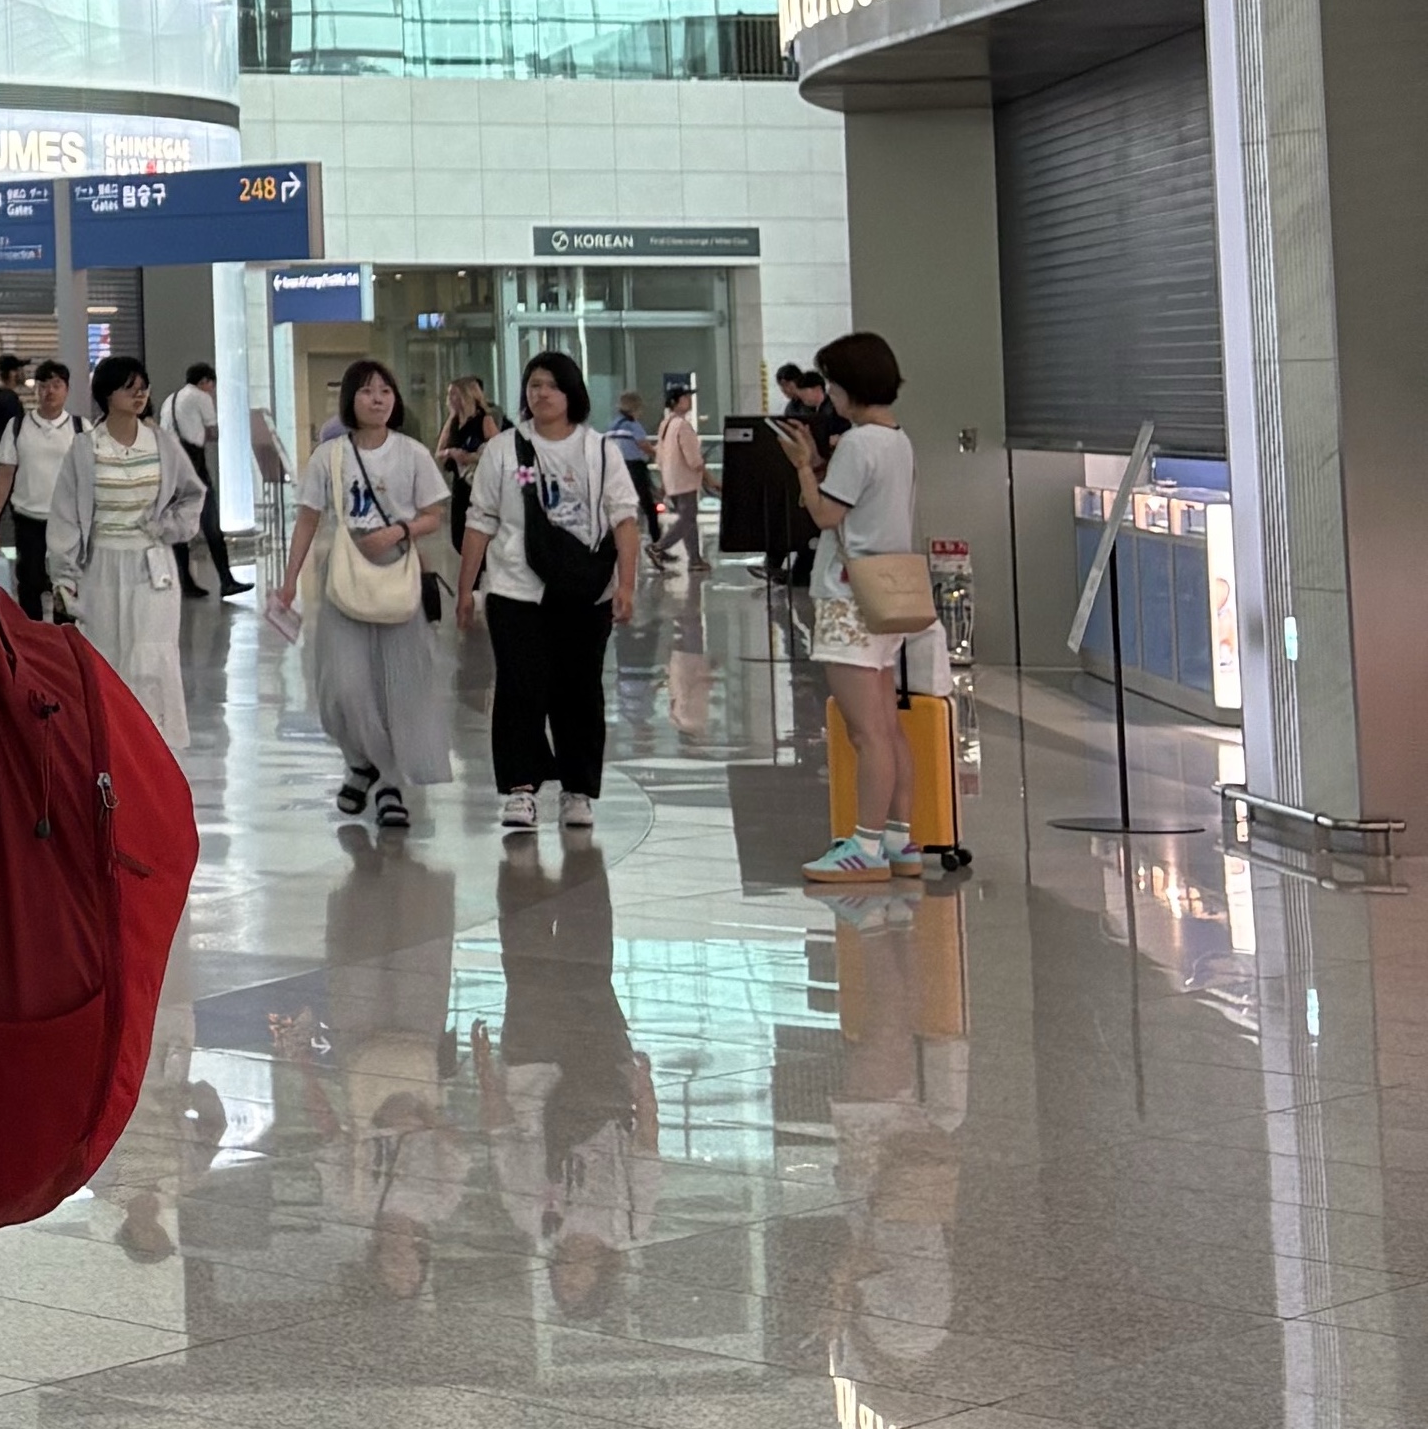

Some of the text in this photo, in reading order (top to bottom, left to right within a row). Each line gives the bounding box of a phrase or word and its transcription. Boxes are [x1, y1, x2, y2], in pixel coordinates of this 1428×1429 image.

[104, 133, 191, 160] SHINSEGAE
[122, 183, 166, 209] 탑승구
[239, 176, 277, 202] 248
[6, 202, 34, 217] Gates
[573, 233, 634, 249] KOREAN
